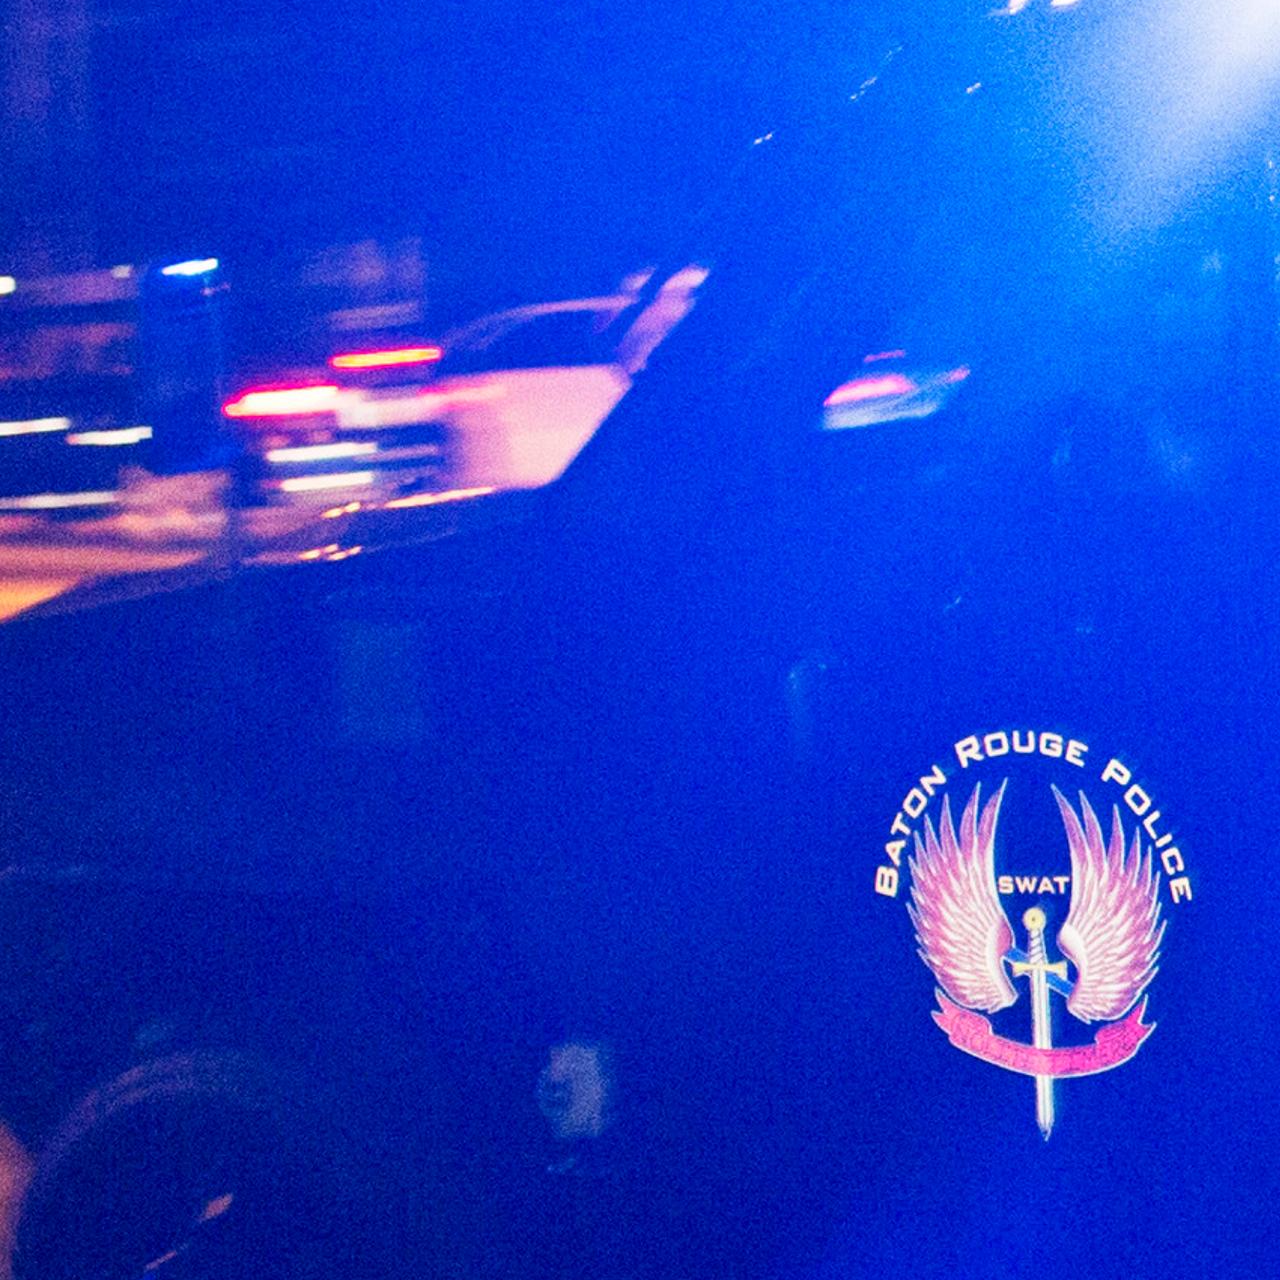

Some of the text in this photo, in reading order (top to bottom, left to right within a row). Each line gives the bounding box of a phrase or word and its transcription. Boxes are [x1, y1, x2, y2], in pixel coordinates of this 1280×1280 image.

[874, 730, 1193, 904] BATON ROUGE POLICE
[997, 875, 1071, 894] SWAT
